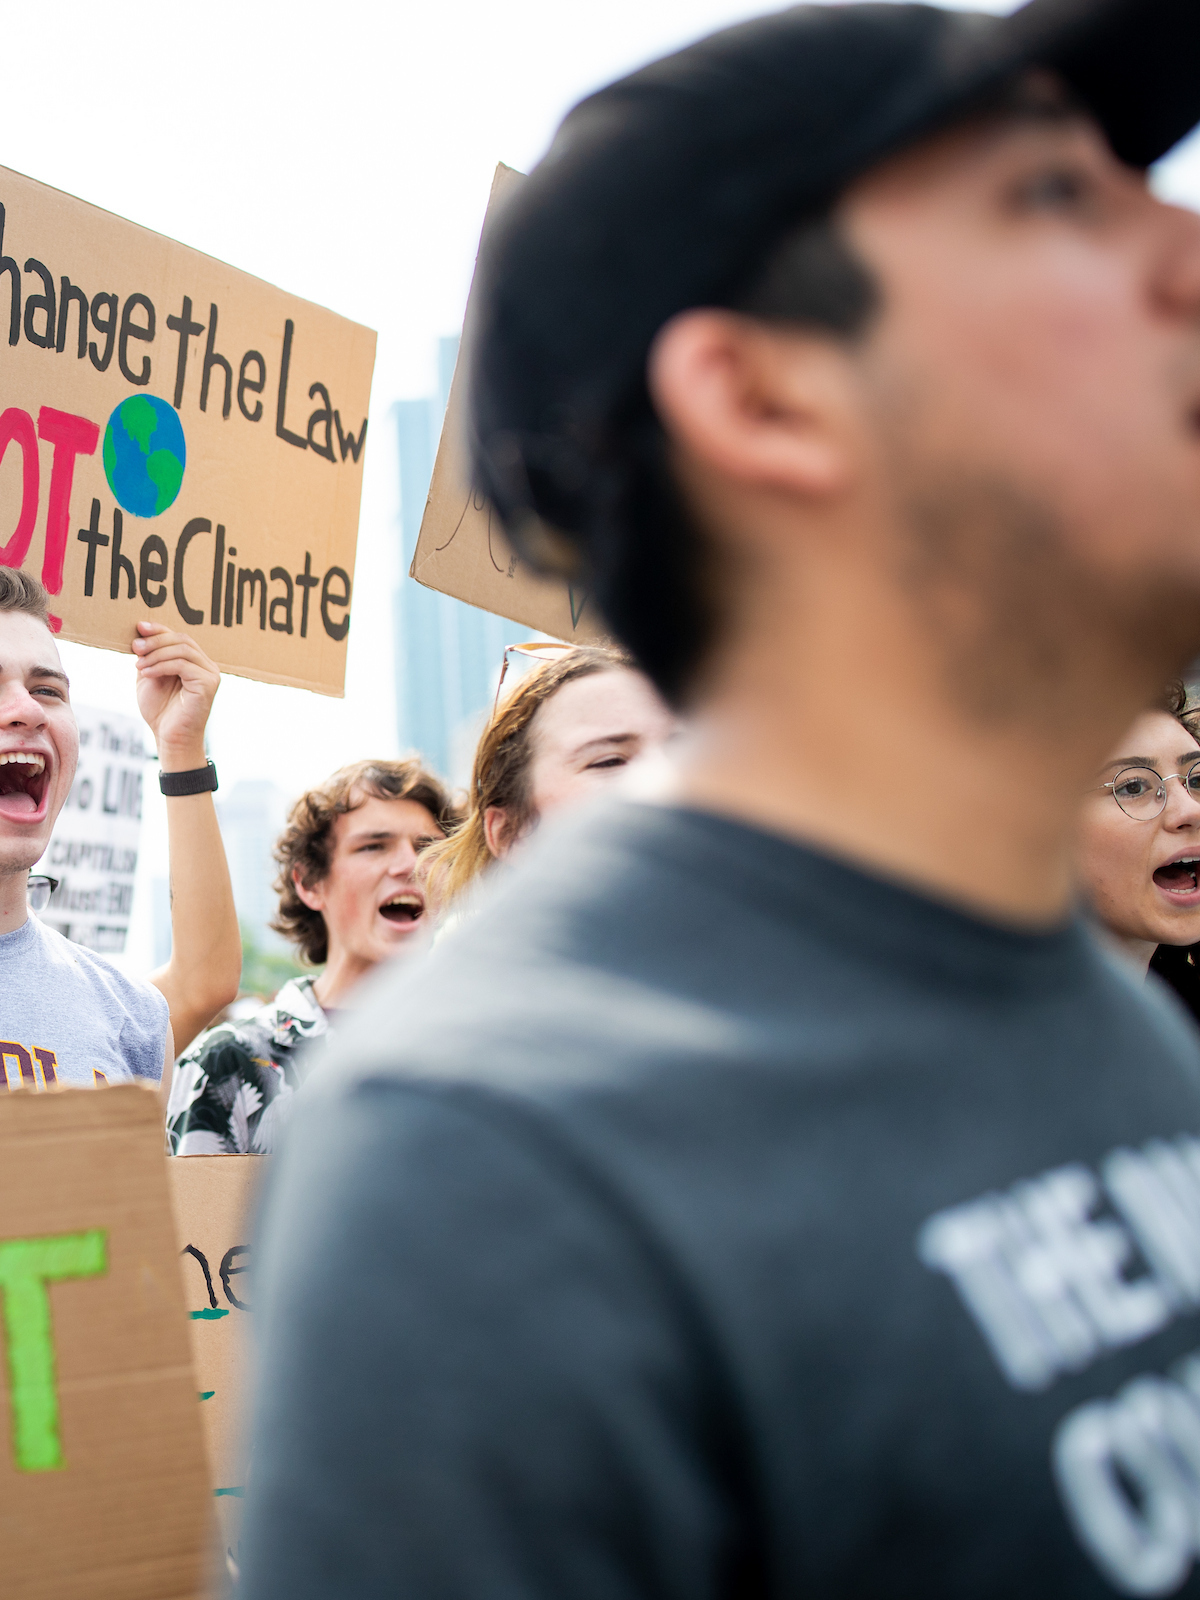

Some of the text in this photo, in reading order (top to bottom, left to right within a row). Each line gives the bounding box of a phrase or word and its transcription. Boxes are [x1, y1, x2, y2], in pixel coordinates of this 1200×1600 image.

[167, 295, 266, 422] the
[276, 319, 368, 463] Law
[77, 497, 169, 608] the
[173, 517, 351, 642] Climate
